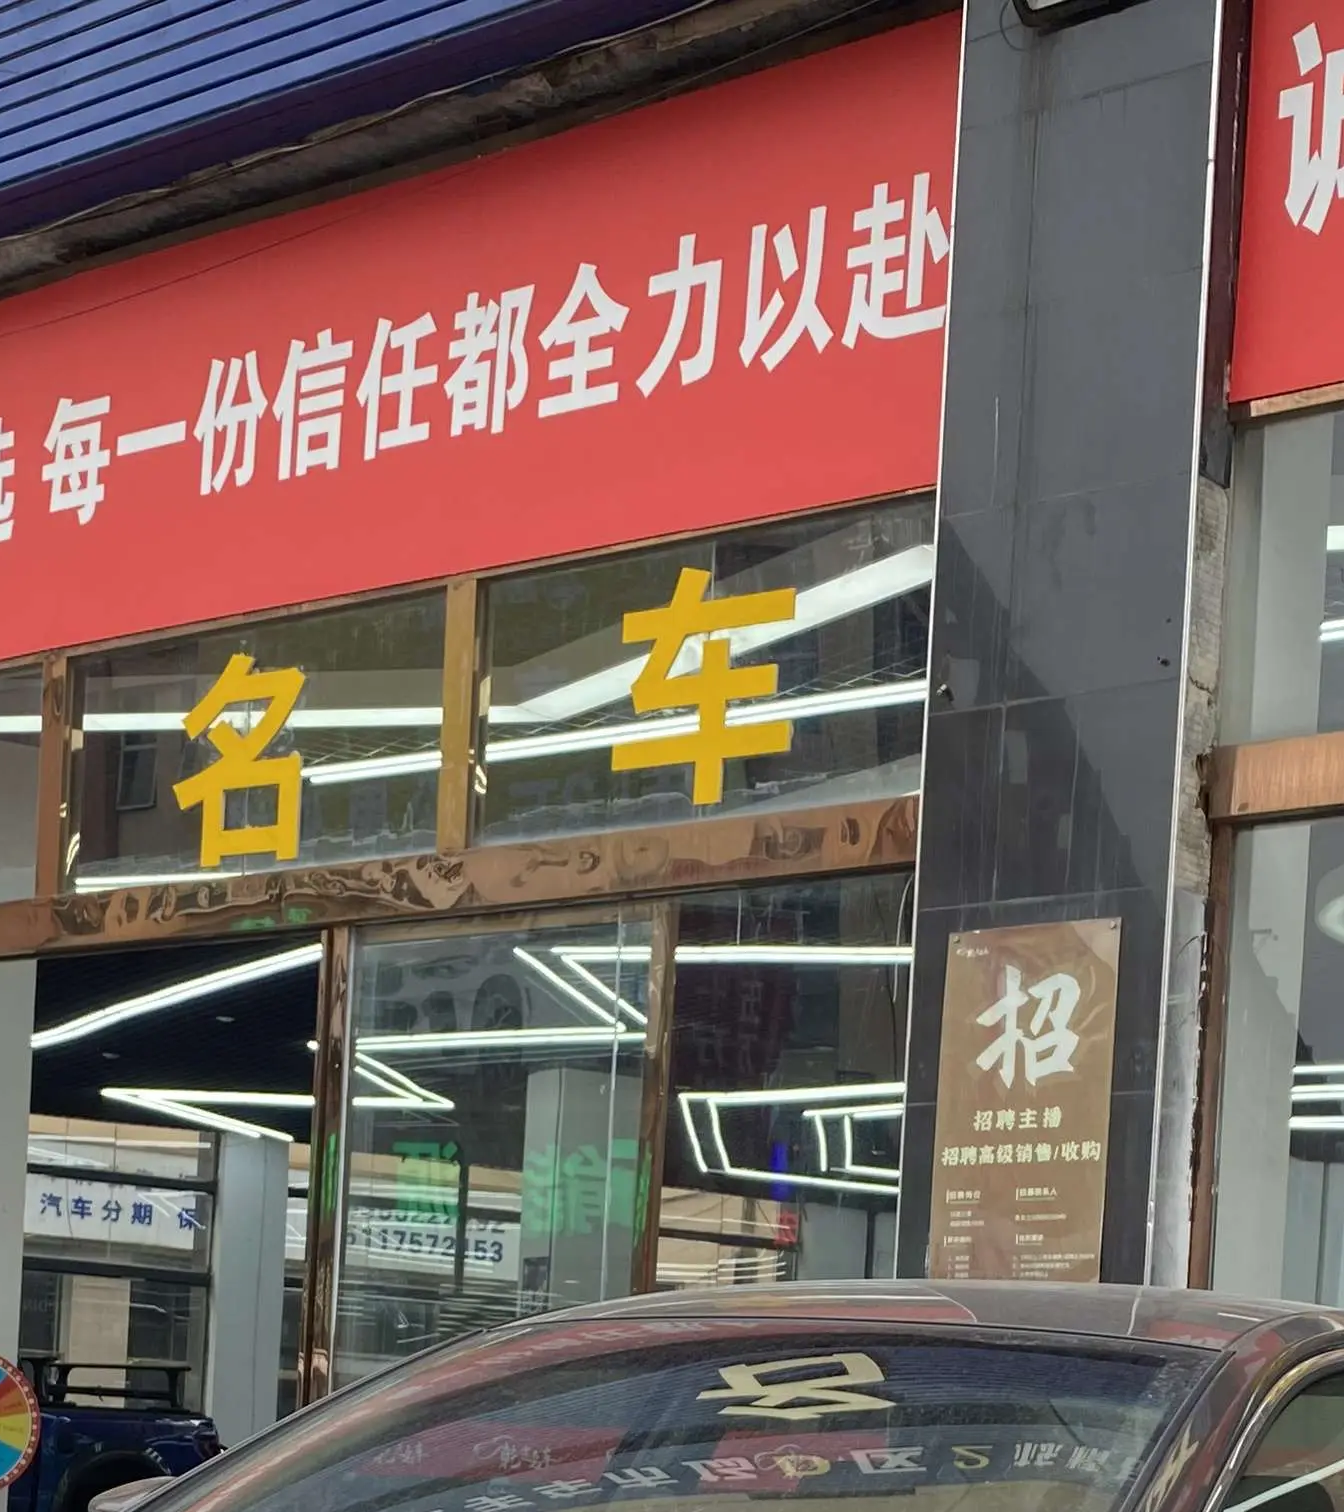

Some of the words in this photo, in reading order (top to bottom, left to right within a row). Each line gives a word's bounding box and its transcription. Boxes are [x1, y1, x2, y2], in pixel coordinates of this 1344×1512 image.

[41, 172, 950, 524] 每一份信任都全力以赴
[975, 963, 1082, 1089] 招
[972, 1105, 1063, 1132] 招聘主播
[940, 1140, 1102, 1167] 招聘高级销售/收购
[40, 1192, 153, 1227] 汽车分期
